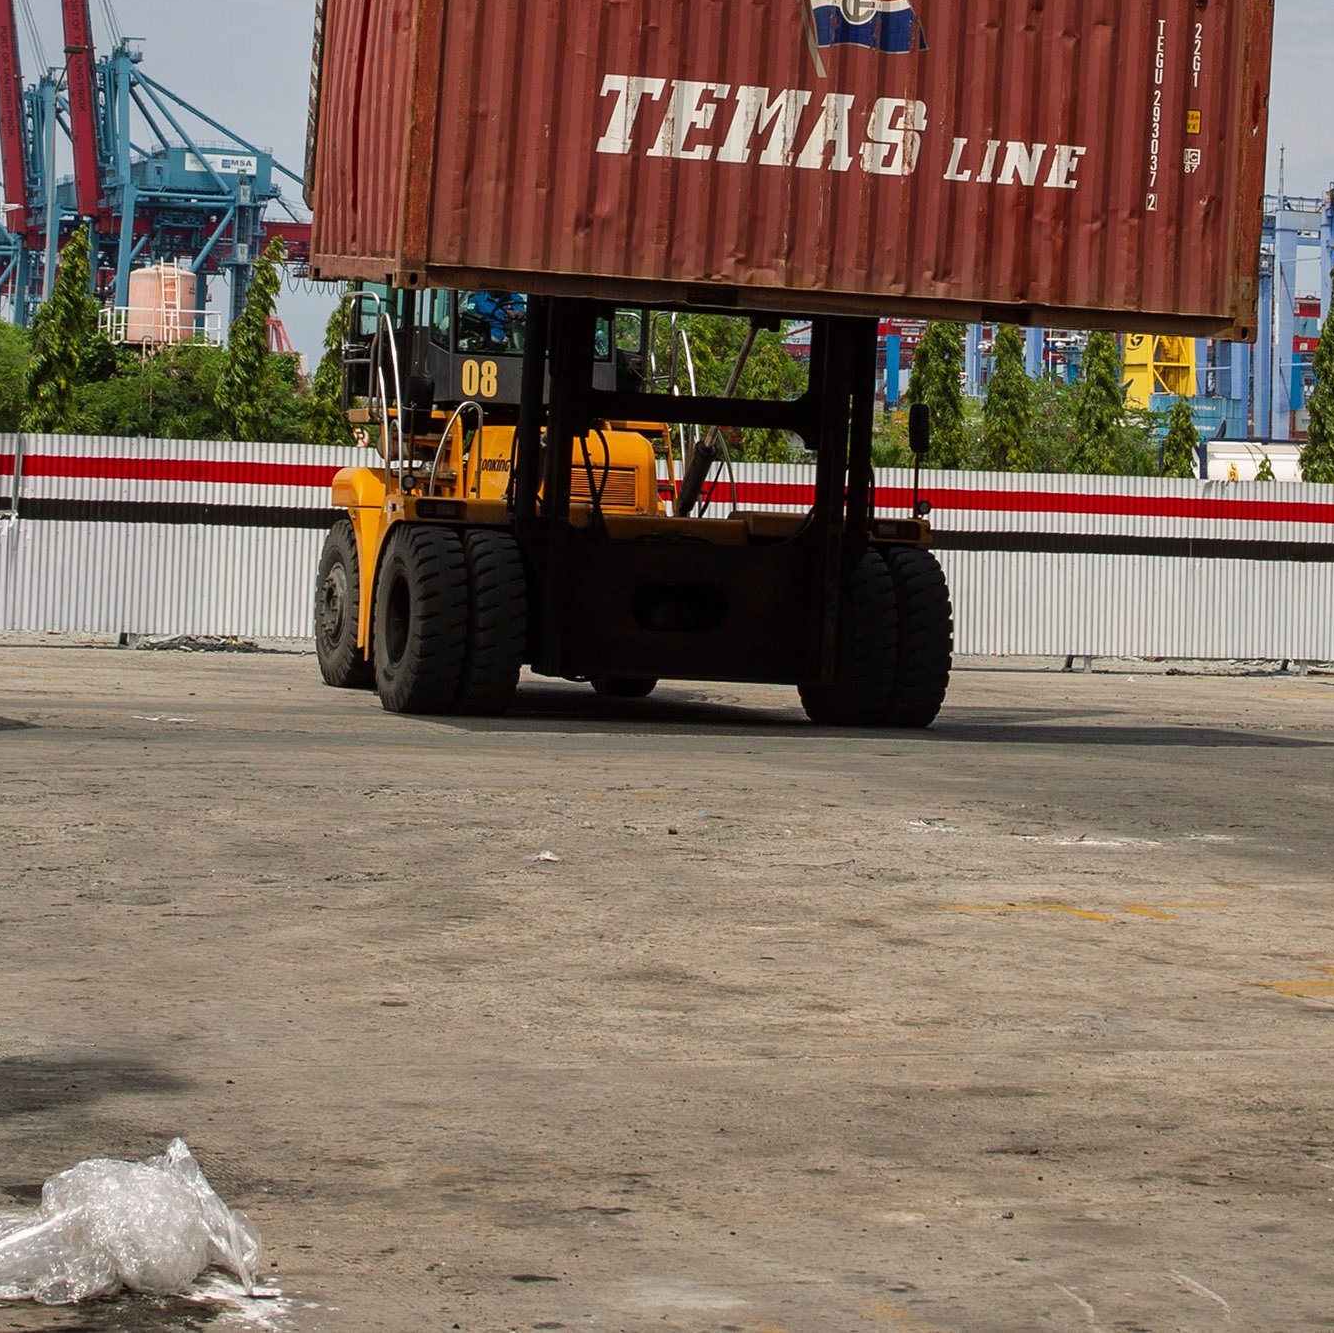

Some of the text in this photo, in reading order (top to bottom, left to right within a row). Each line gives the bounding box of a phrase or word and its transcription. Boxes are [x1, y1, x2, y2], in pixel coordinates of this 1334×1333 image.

[1154, 19, 1166, 85] TEGU
[1192, 22, 1203, 88] 22G1
[596, 74, 1087, 190] TEMAS LINE
[1149, 89, 1161, 187] 293037
[462, 359, 498, 398] 08
